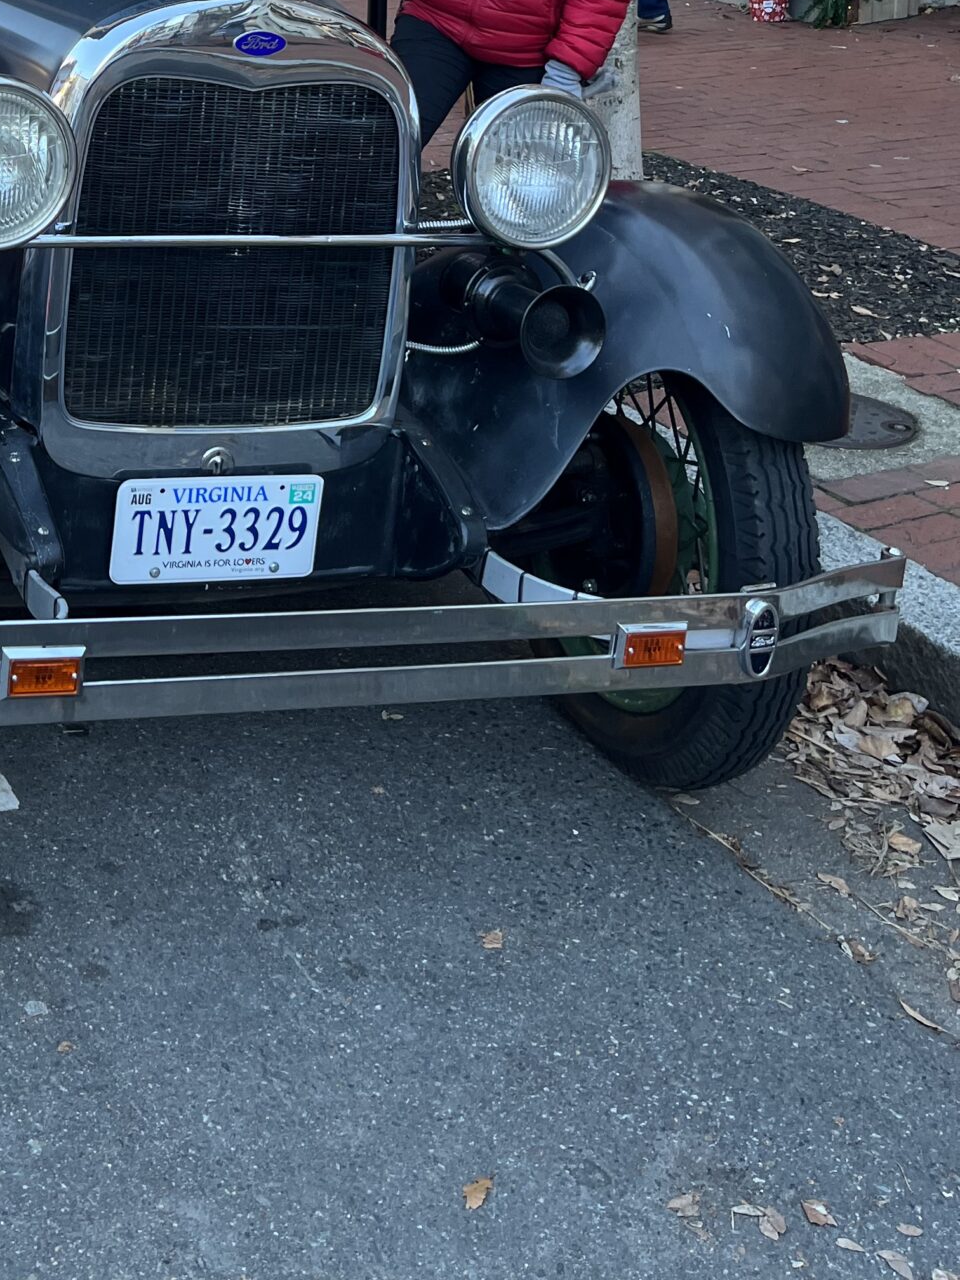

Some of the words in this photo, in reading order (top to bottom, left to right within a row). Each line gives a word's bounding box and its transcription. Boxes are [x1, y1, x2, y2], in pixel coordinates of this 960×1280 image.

[241, 34, 279, 50] Ford
[130, 493, 152, 505] AUG
[172, 485, 269, 504] VIRGINIA
[293, 490, 313, 502] 24
[131, 506, 308, 556] TNY-3329
[162, 560, 202, 569] VIRGINIA
[204, 559, 211, 568] IS
[213, 558, 230, 567] FOR
